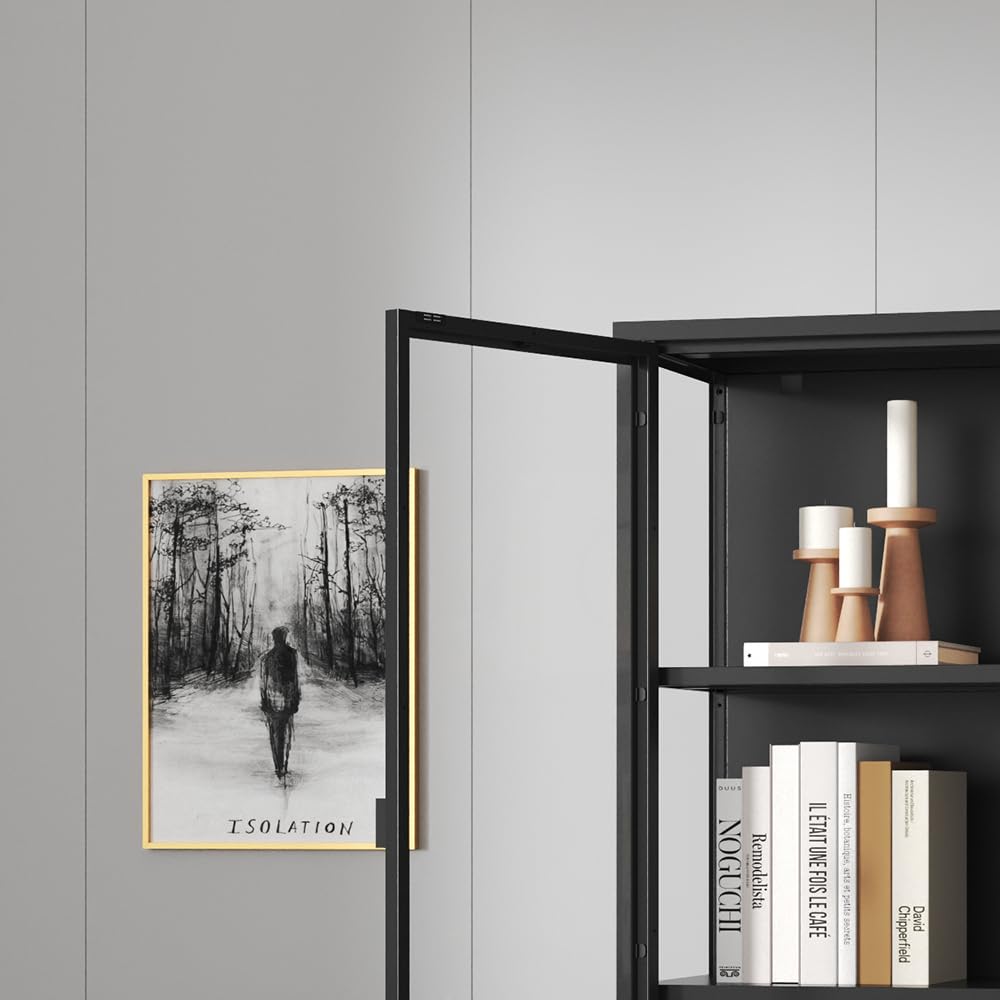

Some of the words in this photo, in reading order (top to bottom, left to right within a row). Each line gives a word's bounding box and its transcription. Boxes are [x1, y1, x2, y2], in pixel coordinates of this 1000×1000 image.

[809, 803, 827, 812] IL
[842, 793, 852, 825] Histoire,
[227, 818, 353, 835] ISOLATION
[809, 815, 831, 844] ÉTAIT
[809, 847, 827, 867] UNE
[842, 827, 851, 865] botanique,
[718, 819, 741, 932] NOGUCHI
[752, 833, 767, 909] Remodelista
[809, 871, 827, 893] FOIS
[809, 897, 827, 909] LE
[842, 895, 851, 916] petits
[809, 912, 831, 938] CAFÉ
[913, 906, 925, 932] David
[896, 905, 911, 963] Chipperfield
